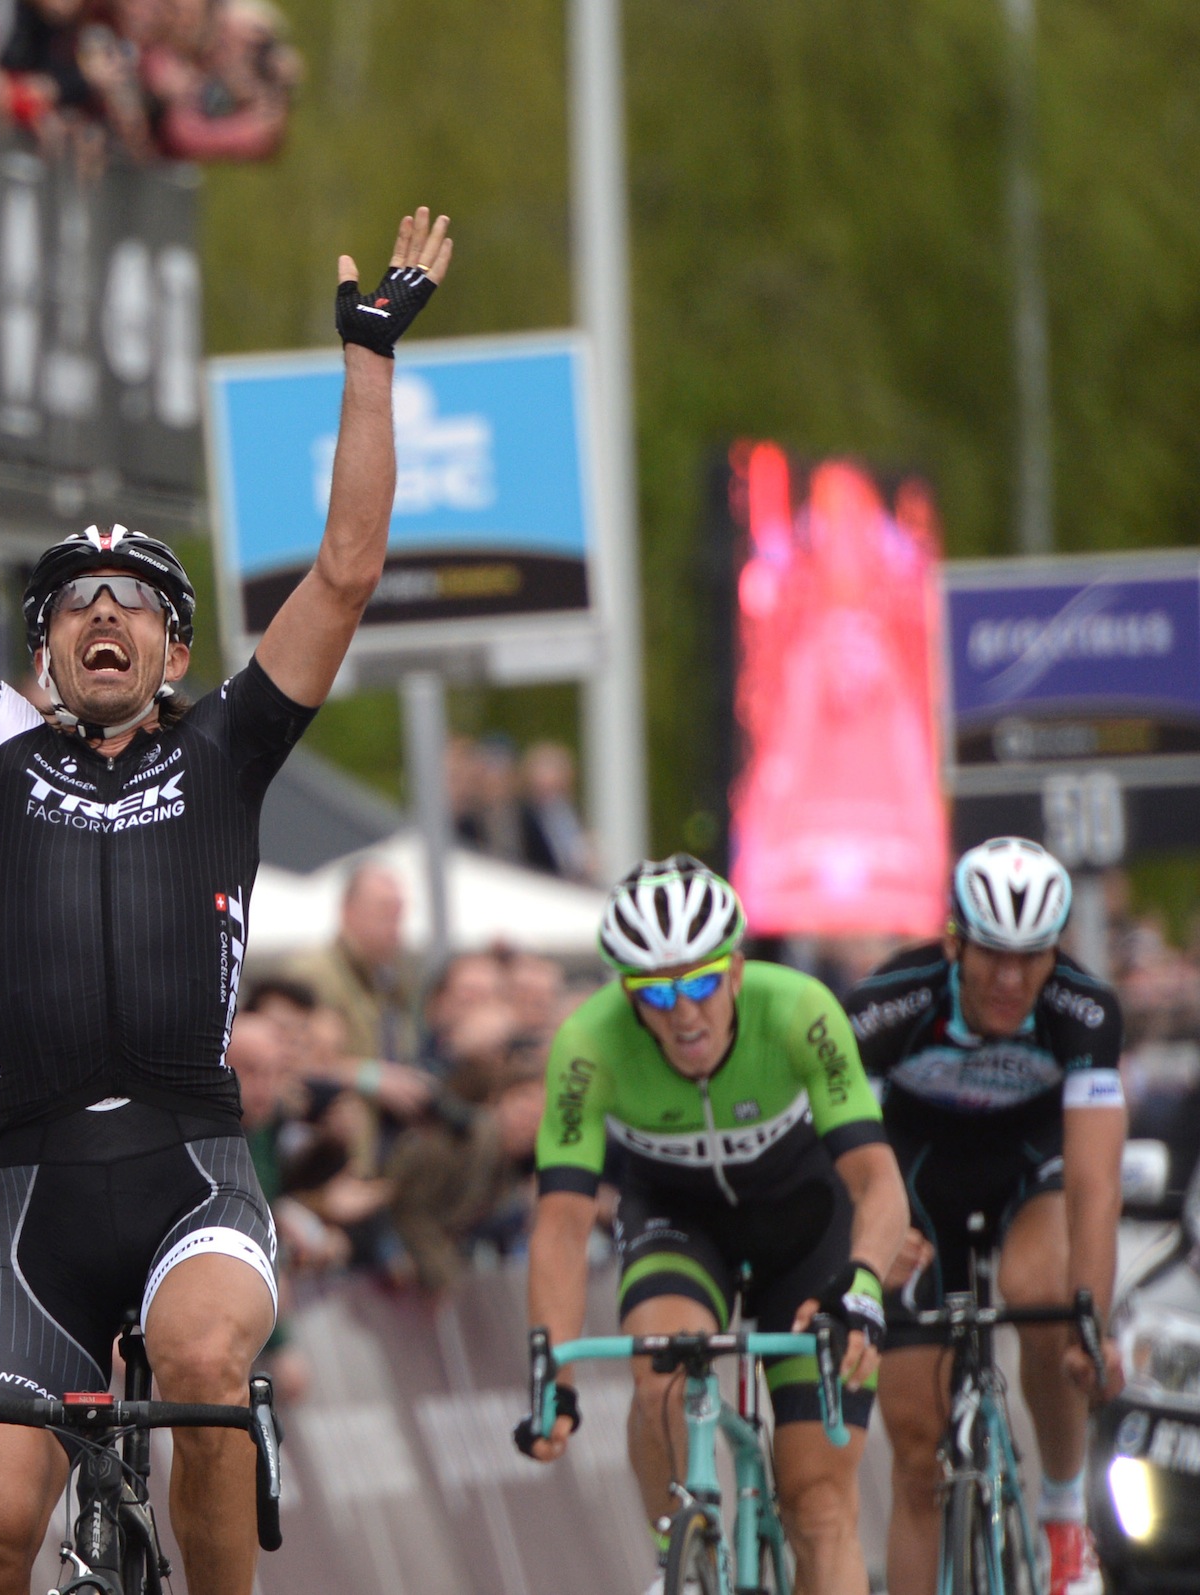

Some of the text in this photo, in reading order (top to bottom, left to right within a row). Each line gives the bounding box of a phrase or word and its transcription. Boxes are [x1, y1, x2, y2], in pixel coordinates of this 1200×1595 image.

[128, 549, 170, 573] BONTRAGER
[25, 767, 186, 821] TREK
[26, 799, 185, 833] FACTORY RACING
[219, 931, 228, 1004] CANCELLARA
[806, 1013, 850, 1107] belkin
[559, 1056, 597, 1147] belkin
[91, 1500, 102, 1560] TREK
